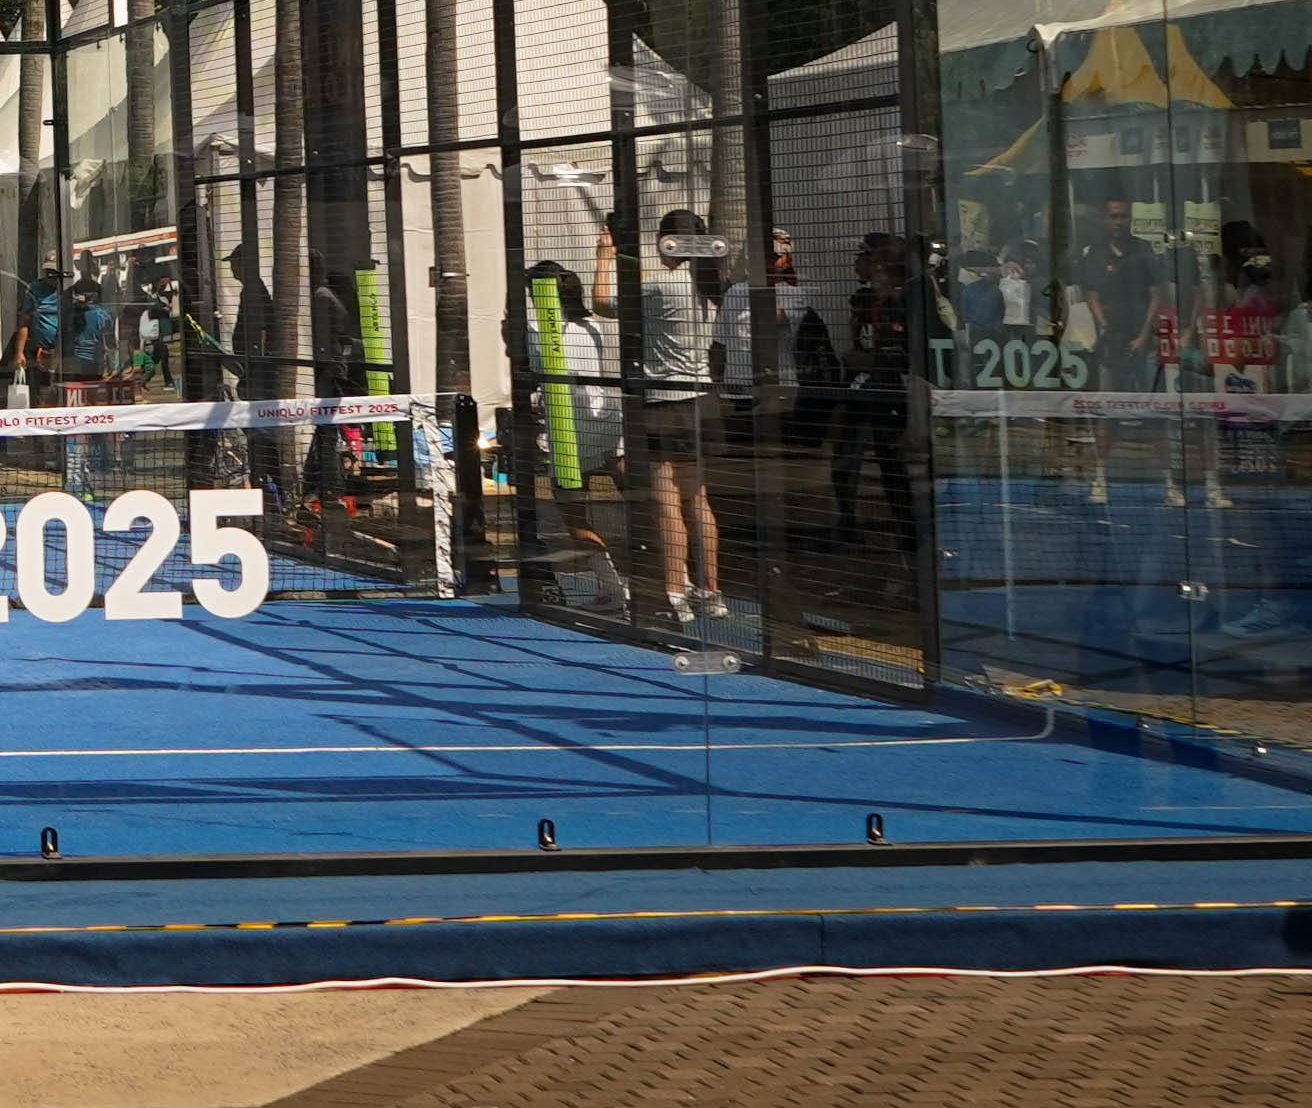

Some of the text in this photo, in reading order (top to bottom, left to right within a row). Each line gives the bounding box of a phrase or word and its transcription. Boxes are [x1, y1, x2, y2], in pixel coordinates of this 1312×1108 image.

[973, 339, 1089, 388] 2025
[258, 403, 399, 420] UNIQLO FITFEST 2025
[25, 415, 78, 427] FITFEST
[84, 414, 115, 425] 2025
